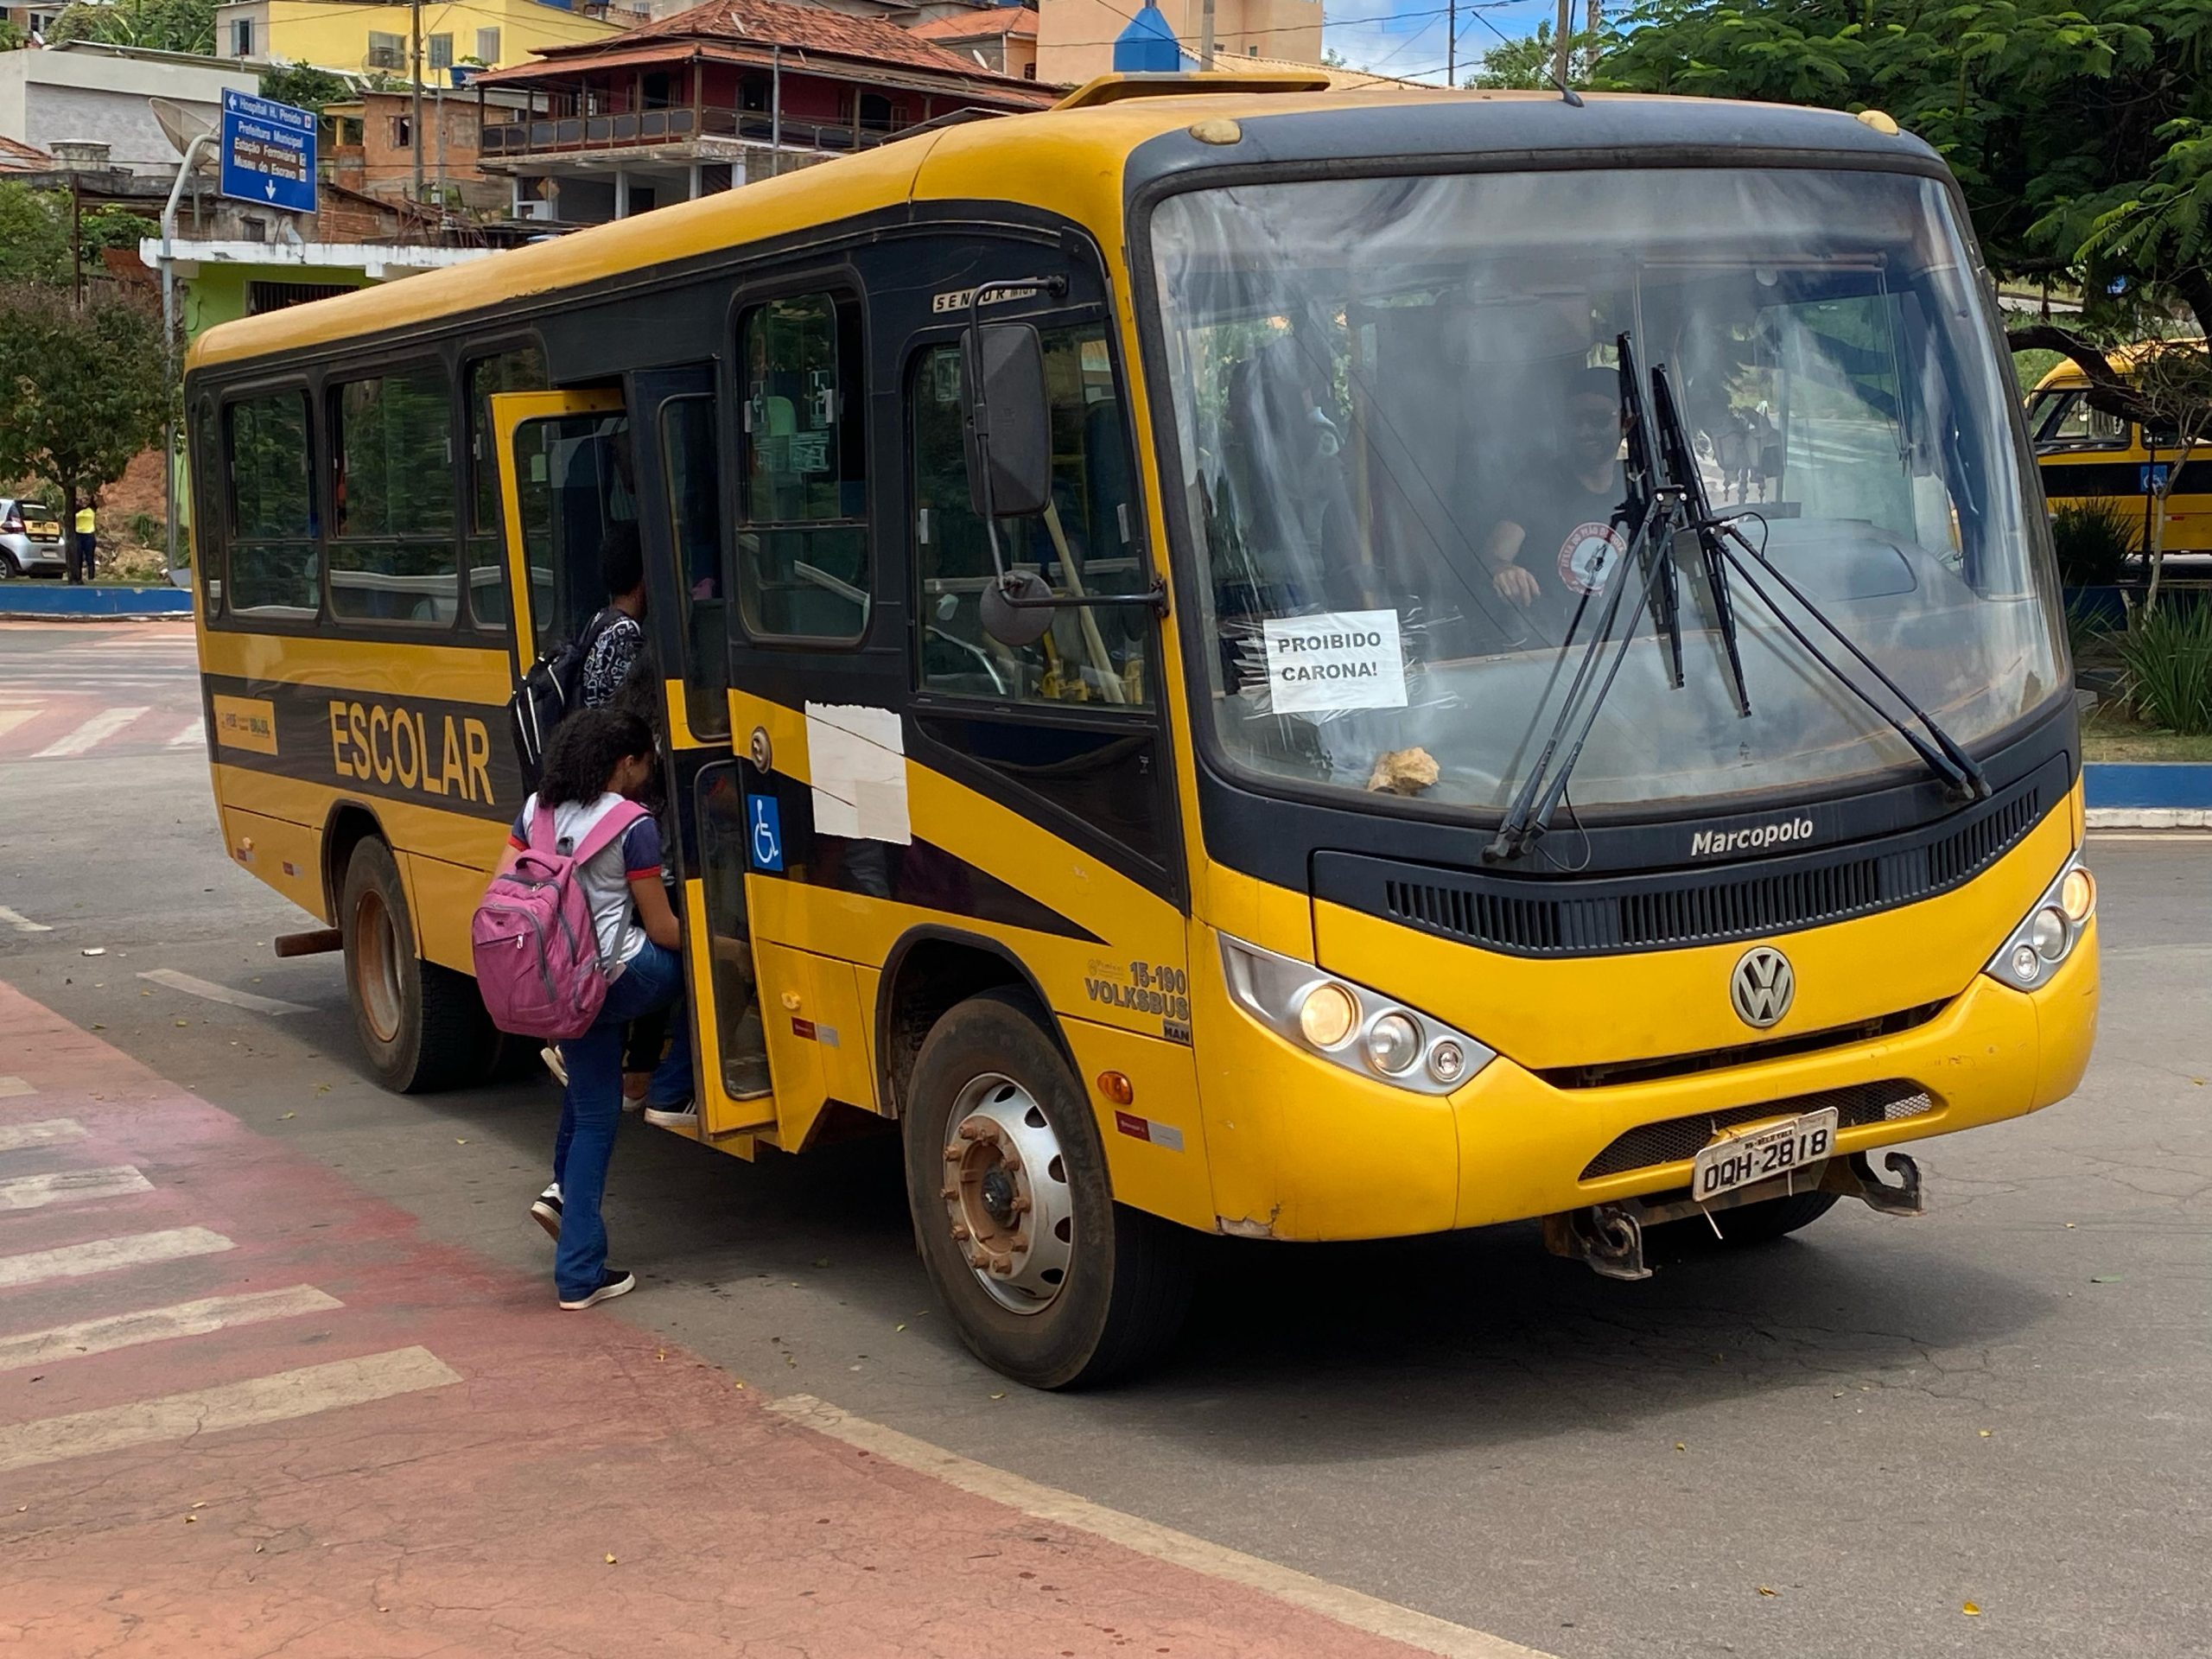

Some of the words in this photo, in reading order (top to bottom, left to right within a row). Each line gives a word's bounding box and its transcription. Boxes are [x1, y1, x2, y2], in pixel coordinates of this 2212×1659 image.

[239, 97, 268, 116] Hospital
[279, 109, 302, 125] Penido
[234, 137, 260, 155] Estação
[238, 120, 271, 141] Prefeitura
[273, 130, 303, 148] Municipal
[233, 154, 256, 171] Museu
[258, 161, 268, 173] do
[270, 162, 296, 180] Escravo
[936, 288, 1005, 310] SENOR
[1278, 632, 1381, 653] PROIBIDO
[1281, 661, 1377, 682] CARONA!
[329, 700, 495, 806] ESCOLAR
[1691, 817, 1813, 856] Marcopolo
[1129, 961, 1186, 995] 15-190
[1734, 949, 1792, 1024] VW
[1084, 977, 1189, 1020] VOLKSBUS
[1164, 1026, 1189, 1041] MAN
